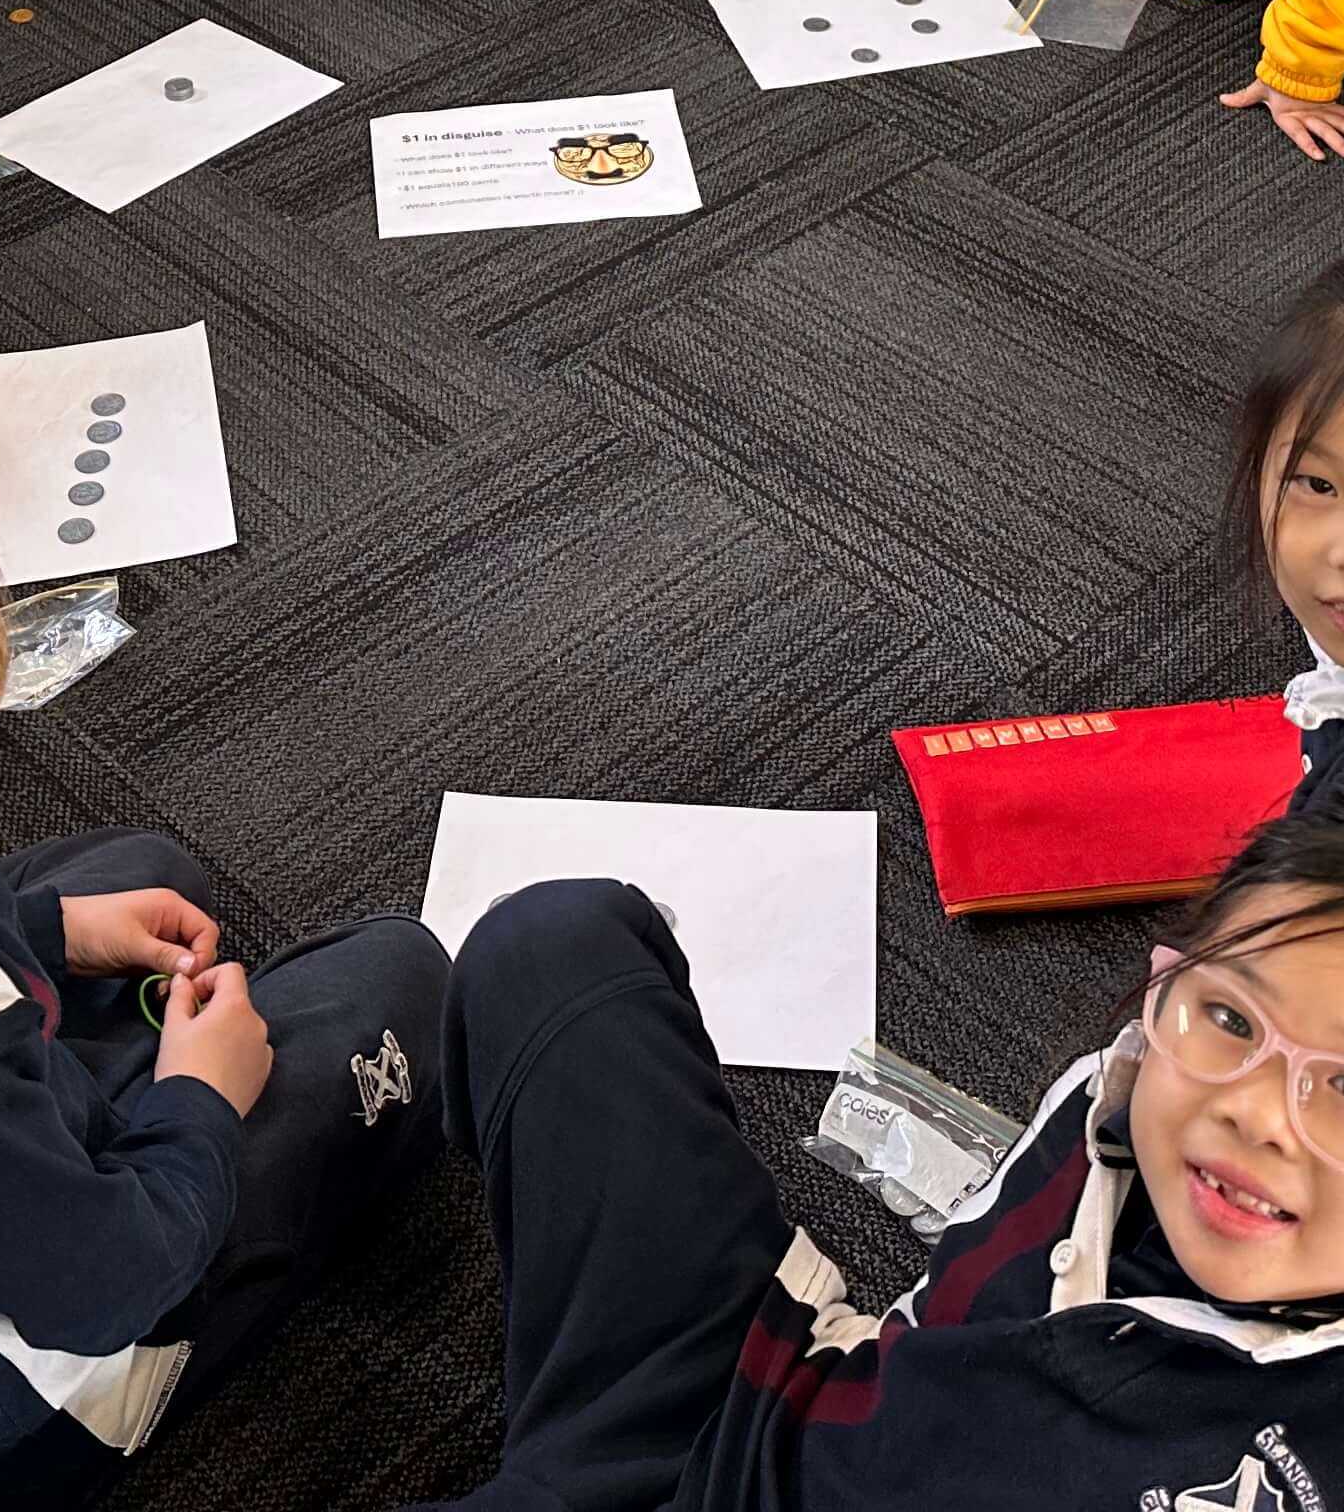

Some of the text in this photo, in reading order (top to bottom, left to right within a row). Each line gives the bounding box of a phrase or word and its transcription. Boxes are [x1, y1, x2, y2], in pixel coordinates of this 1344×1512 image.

[401, 134, 419, 143] $1
[424, 133, 438, 142] in
[441, 129, 503, 140] disguise
[514, 127, 546, 135] What
[577, 123, 590, 131] $1
[594, 121, 618, 130] look
[619, 119, 645, 127] like?
[400, 154, 427, 163] What
[455, 165, 467, 173] $1
[481, 161, 521, 171] different
[405, 201, 437, 210] Which
